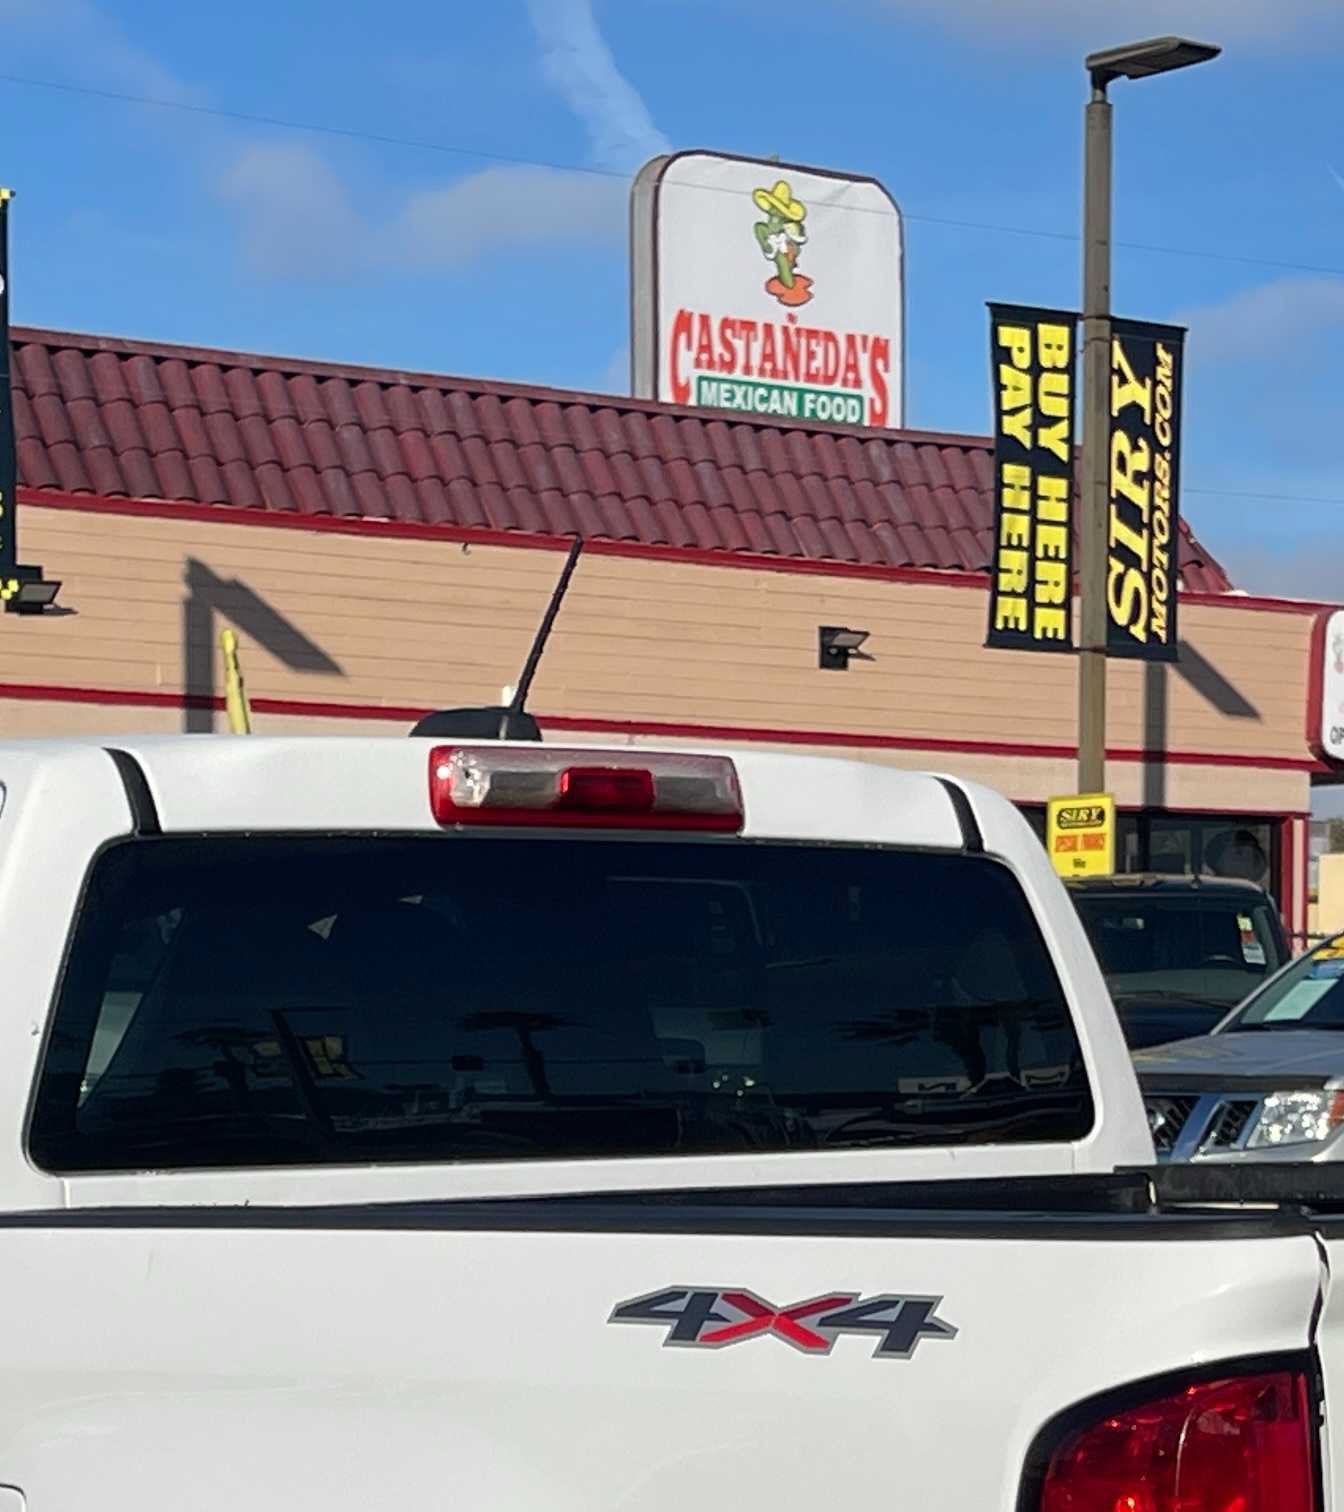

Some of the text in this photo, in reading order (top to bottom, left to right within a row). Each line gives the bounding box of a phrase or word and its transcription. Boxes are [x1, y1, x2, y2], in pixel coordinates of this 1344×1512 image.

[700, 380, 861, 423] MEXICAN FOOD
[996, 326, 1032, 631] PAY HERE
[1033, 323, 1069, 640] BUY HERE
[1108, 335, 1151, 644] SIRY
[1151, 343, 1173, 644] MOTORS.COM
[1060, 808, 1102, 821] SIRY
